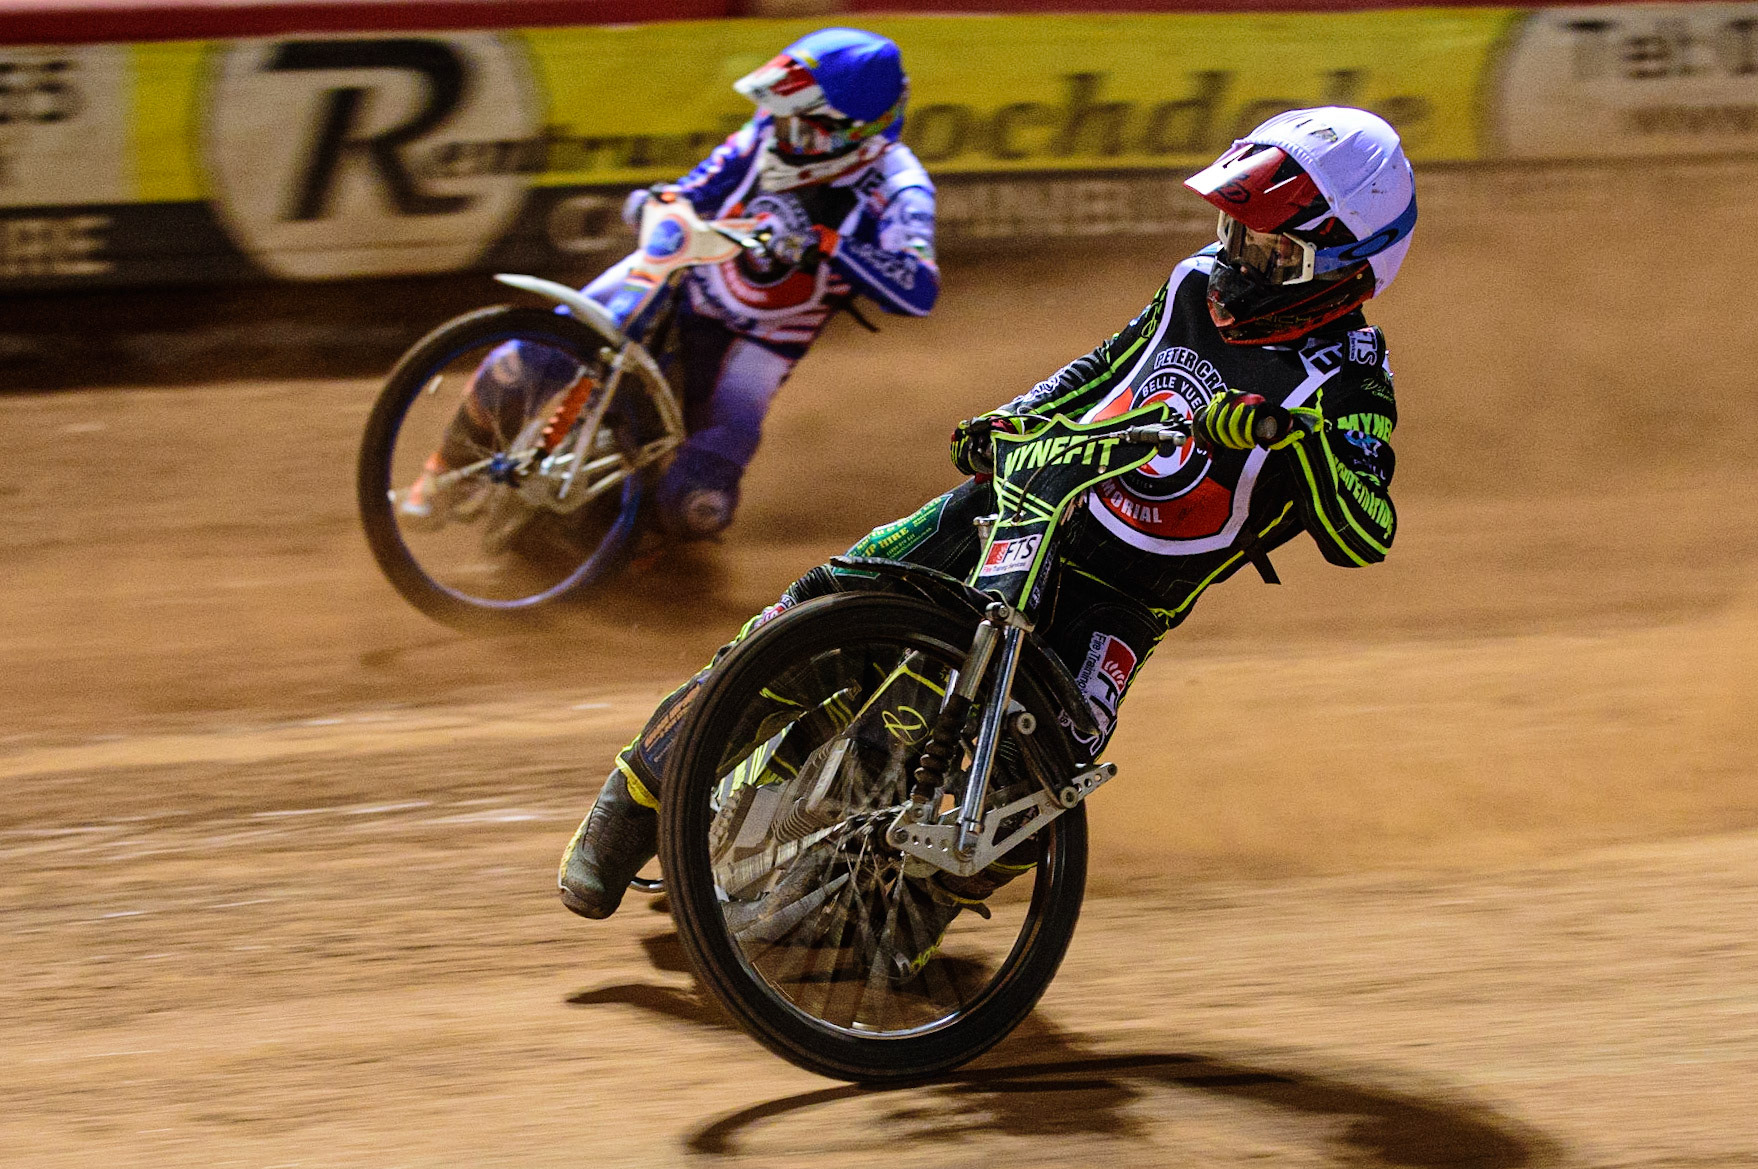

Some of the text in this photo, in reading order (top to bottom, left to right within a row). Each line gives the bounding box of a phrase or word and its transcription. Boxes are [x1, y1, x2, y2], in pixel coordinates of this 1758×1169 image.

[1154, 347, 1198, 371] PETER
[1142, 376, 1203, 409] BELLE VUE
[1101, 478, 1162, 523] MORIAL
[1002, 536, 1038, 563] FTS
[1091, 635, 1106, 651] Fire
